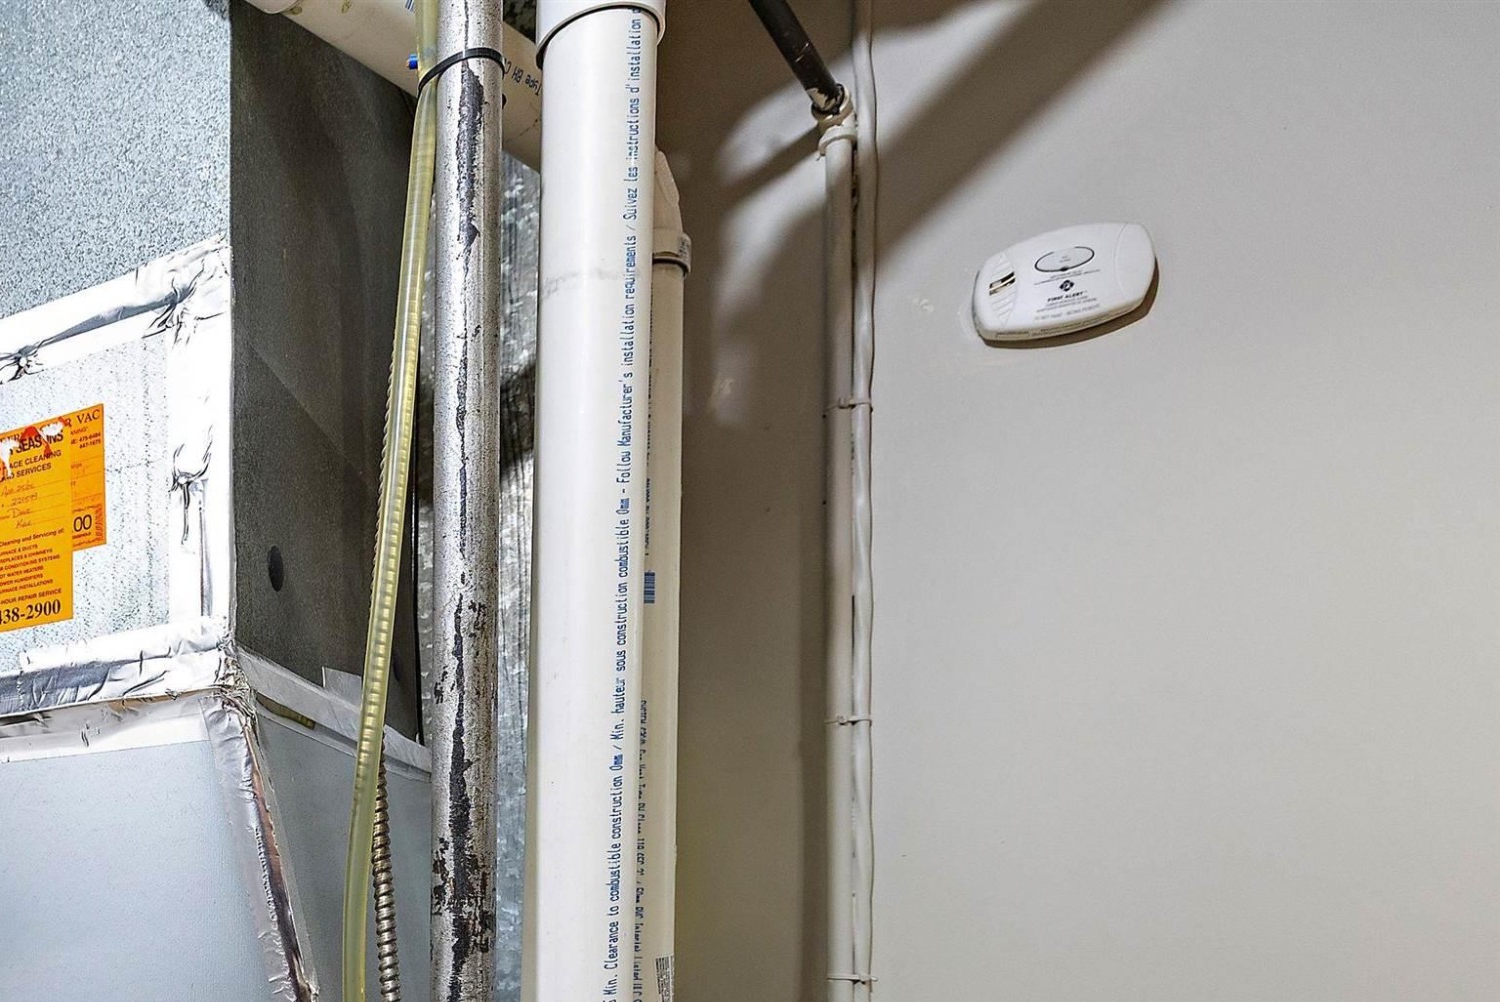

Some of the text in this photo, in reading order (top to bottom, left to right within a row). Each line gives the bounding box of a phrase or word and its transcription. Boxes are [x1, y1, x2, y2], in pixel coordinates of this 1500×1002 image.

[625, 98, 640, 161] instructions
[623, 166, 638, 181] les
[623, 188, 639, 220] Suivez
[622, 236, 637, 300] requirements
[620, 304, 635, 366] installation
[76, 409, 100, 424] VAC
[617, 372, 634, 447] Manufacturer's
[16, 431, 63, 454] SEASNS
[24, 450, 62, 466] CLEANING
[16, 463, 52, 477] SERVICES
[616, 450, 631, 483] Follow
[0, 538, 21, 548] Cleaning
[32, 530, 57, 540] Servicing
[612, 519, 629, 578] combustible
[18, 593, 37, 601] REPAIR
[39, 588, 62, 597] SERVICE
[612, 582, 628, 646] construction
[614, 650, 626, 672] sous
[610, 678, 625, 714] hauteur
[610, 718, 625, 740] Min.
[608, 775, 623, 839] construction
[606, 842, 621, 902] combustible
[606, 905, 619, 916] to
[603, 921, 619, 970] Clearance
[603, 974, 618, 995] Min.
